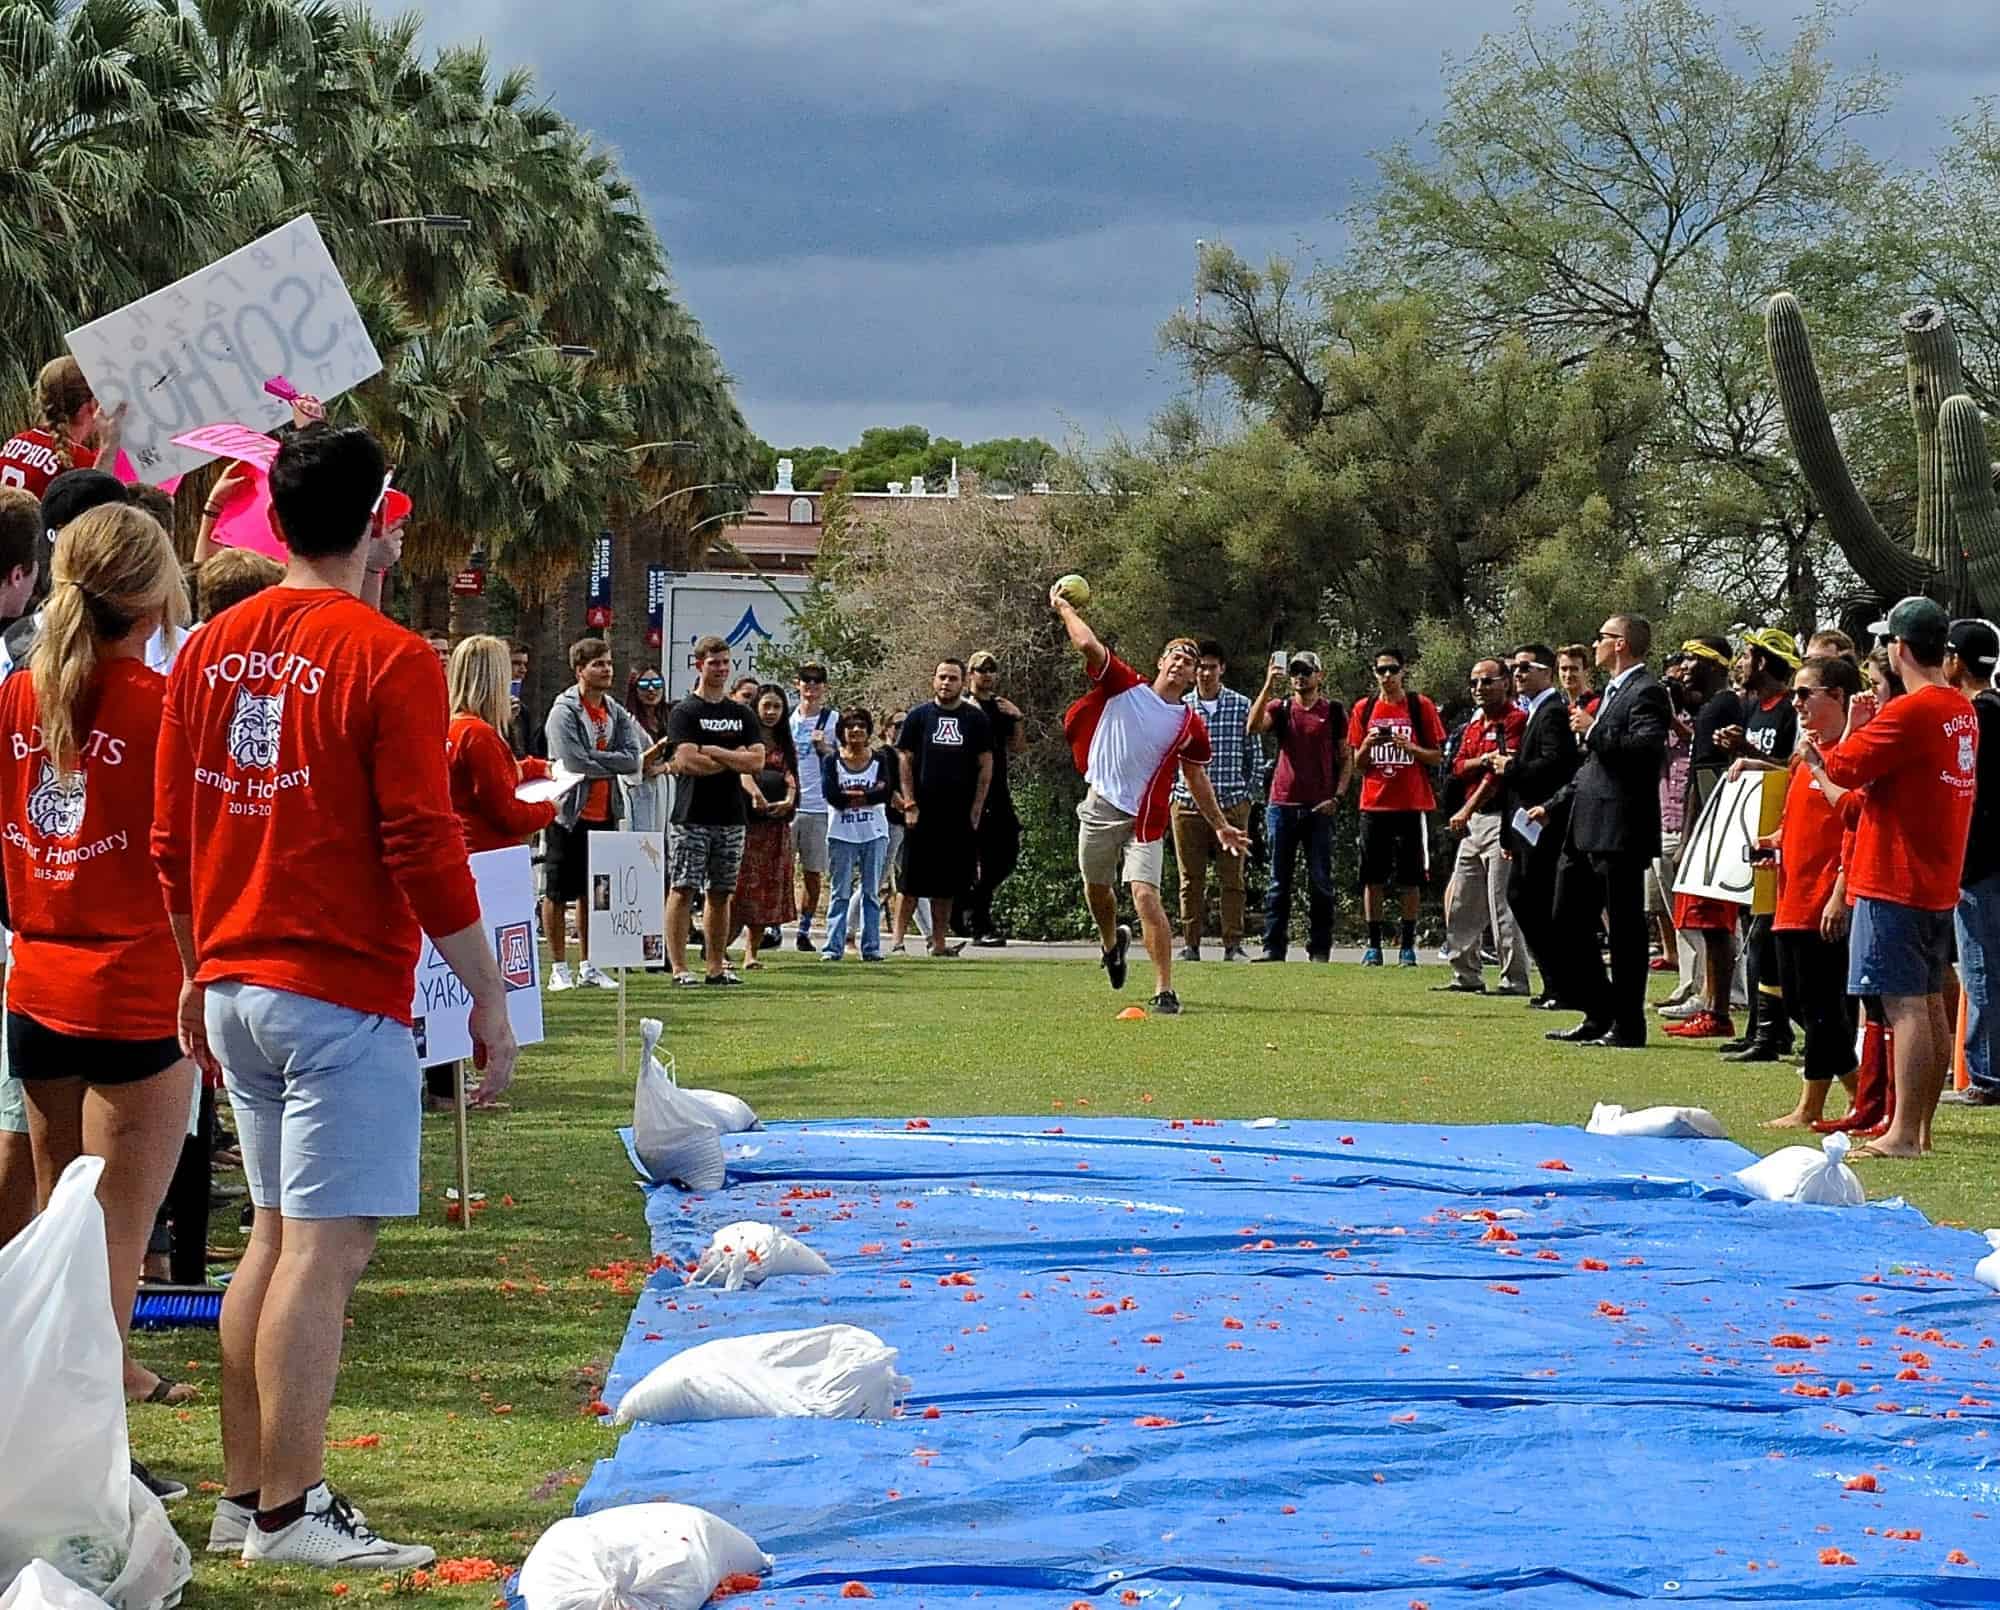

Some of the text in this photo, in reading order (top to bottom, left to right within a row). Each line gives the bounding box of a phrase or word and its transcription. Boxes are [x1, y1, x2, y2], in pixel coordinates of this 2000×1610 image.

[932, 717, 964, 745] A
[617, 866, 639, 905] 10
[610, 909, 643, 936] YARDS
